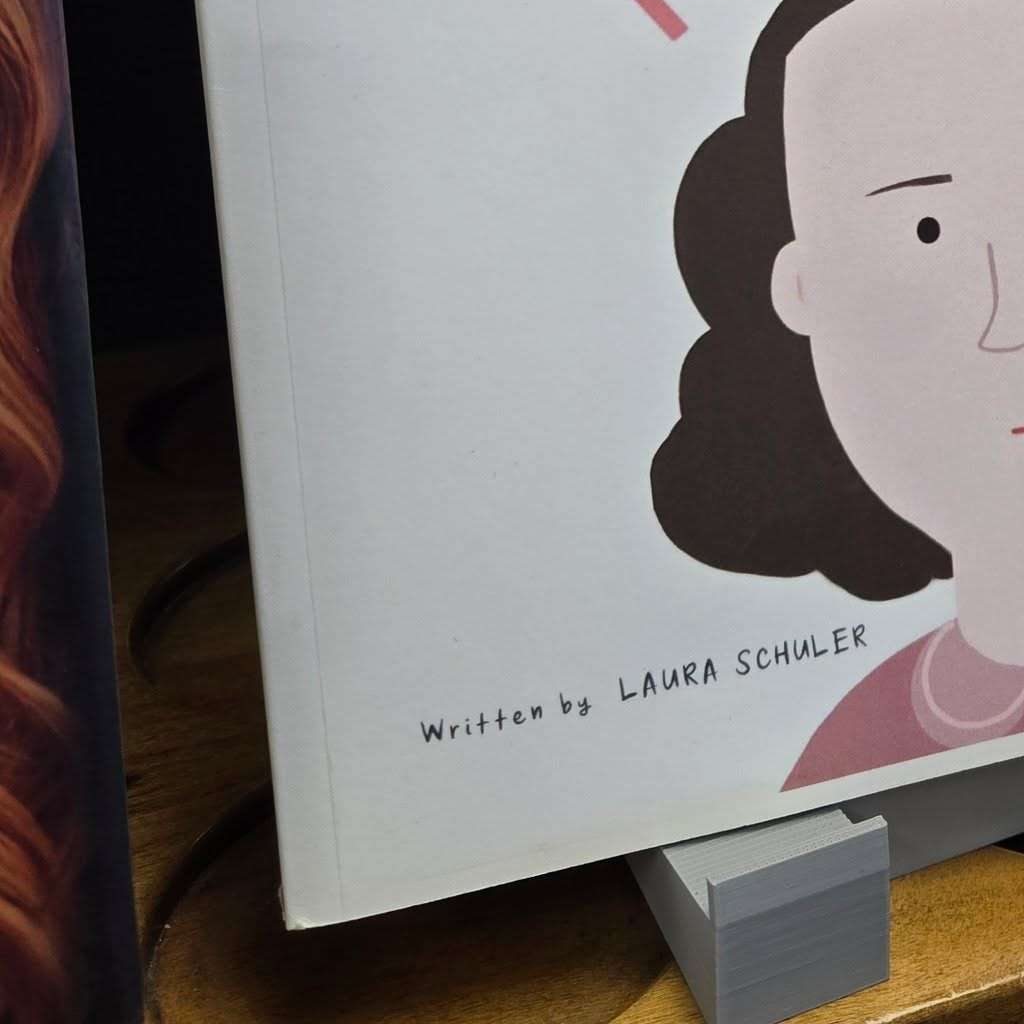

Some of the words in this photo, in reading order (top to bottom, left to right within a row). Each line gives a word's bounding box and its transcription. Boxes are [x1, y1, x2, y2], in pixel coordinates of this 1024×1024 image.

[420, 703, 544, 744] Written
[559, 692, 593, 717] by
[618, 657, 718, 703] LAURA
[735, 623, 868, 676] SCHULER
